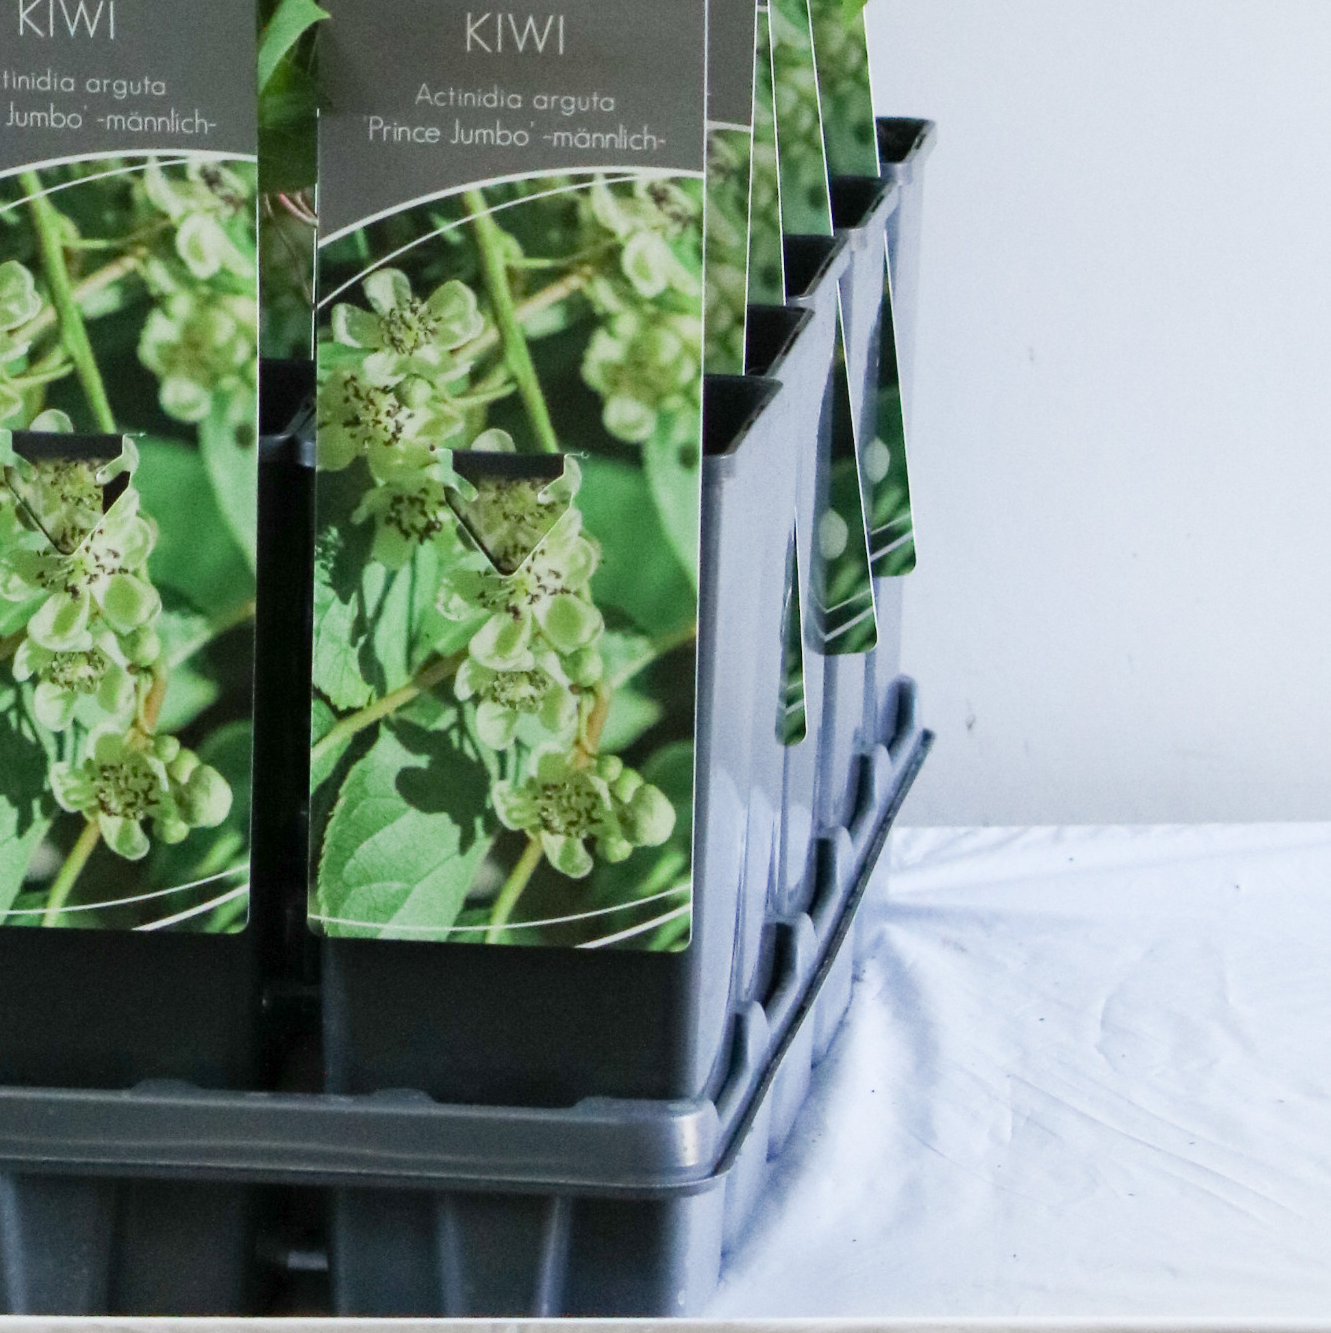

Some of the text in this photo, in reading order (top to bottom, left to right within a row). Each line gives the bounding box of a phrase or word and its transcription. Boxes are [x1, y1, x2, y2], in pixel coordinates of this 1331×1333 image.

[465, 11, 565, 55] KIWI
[85, 72, 167, 101] arguta
[414, 83, 616, 117] Actinidia arguta
